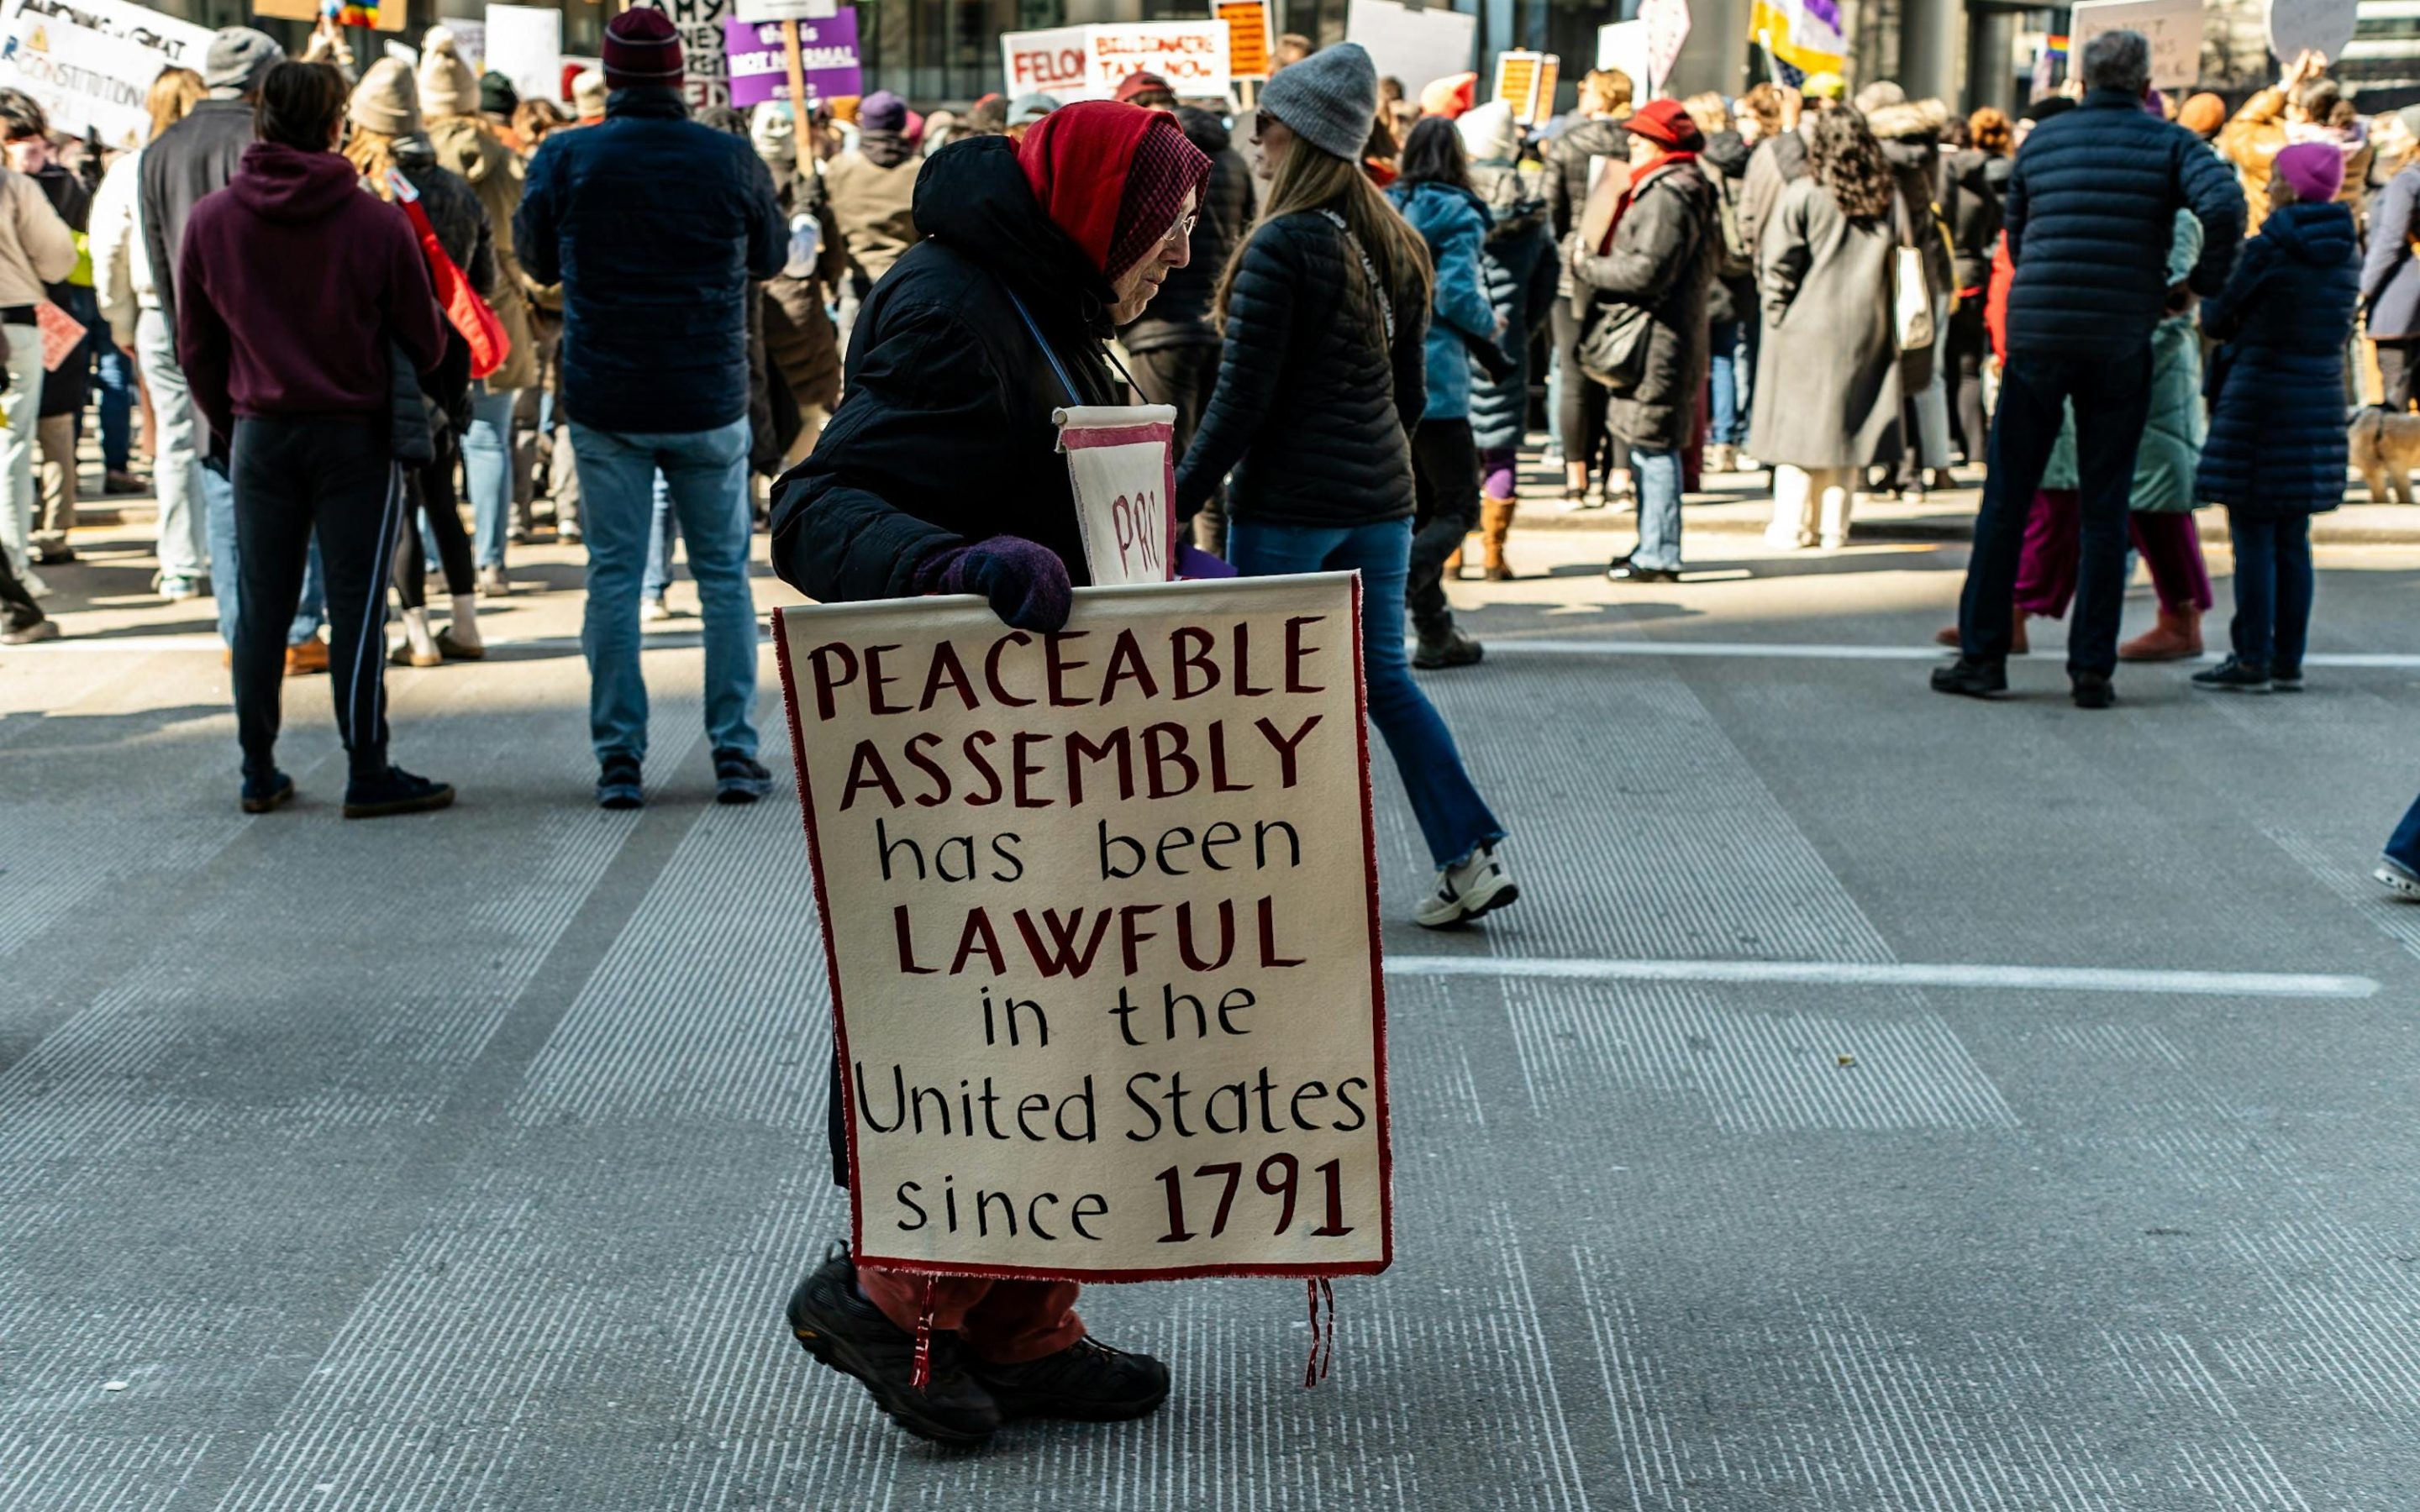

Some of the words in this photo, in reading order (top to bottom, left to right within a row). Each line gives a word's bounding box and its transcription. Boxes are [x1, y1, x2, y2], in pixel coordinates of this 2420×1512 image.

[771, 45, 859, 69] NRMAL
[807, 615, 1327, 722] PEACEABLE
[839, 714, 1324, 812] ASSEMBLY
[875, 816, 1024, 883] has
[1097, 818, 1301, 882] been
[893, 895, 1307, 980] LAWFUL
[980, 985, 1050, 1048] in
[1107, 982, 1257, 1047] the
[855, 1060, 1097, 1144] United
[1124, 1066, 1370, 1143] States
[896, 1174, 1110, 1242] since
[1154, 1152, 1355, 1243] 1791
